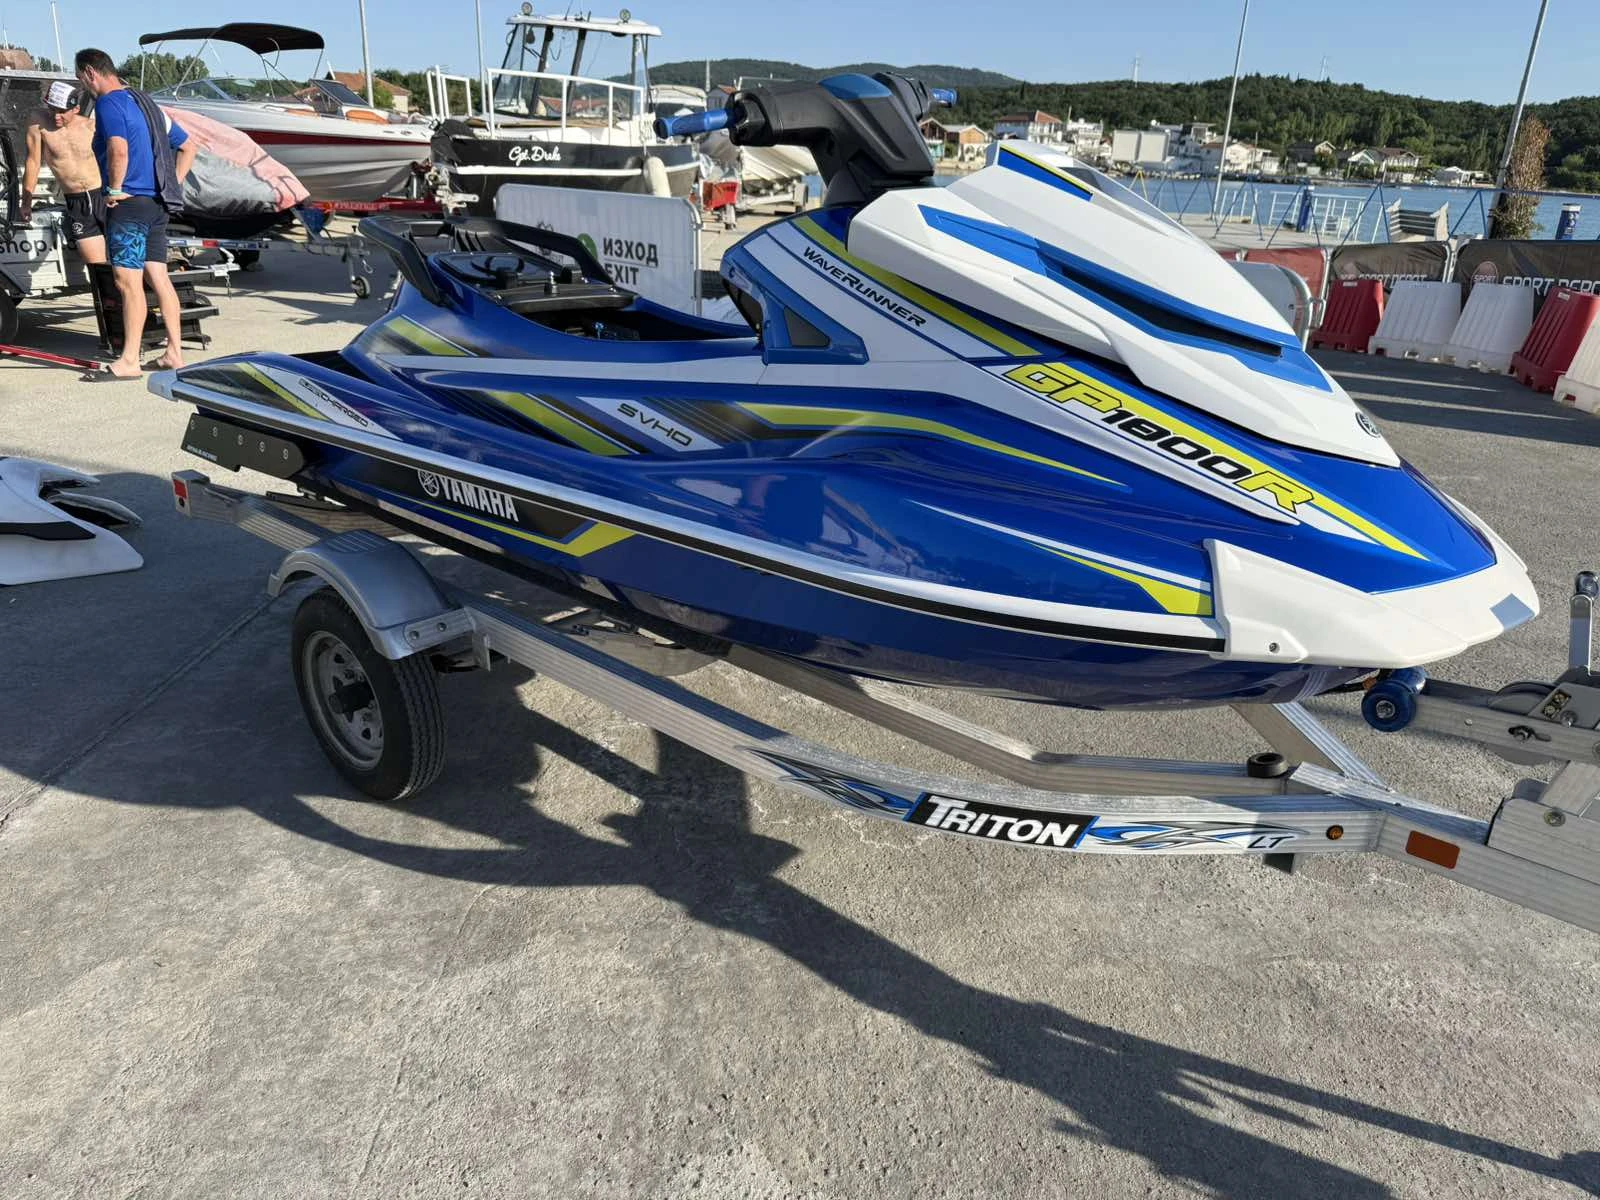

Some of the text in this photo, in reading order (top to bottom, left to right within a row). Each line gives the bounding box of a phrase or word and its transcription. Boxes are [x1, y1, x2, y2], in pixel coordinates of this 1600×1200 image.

[603, 237, 659, 267] ИЗХОД
[604, 263, 640, 285] EXIT
[803, 246, 927, 327] WAVERUNNER
[617, 403, 693, 446] SVHO
[1001, 362, 1315, 514] GP1800R
[440, 475, 519, 522] YAMAHA
[924, 795, 1080, 847] TRITON
[1246, 834, 1295, 850] LT
